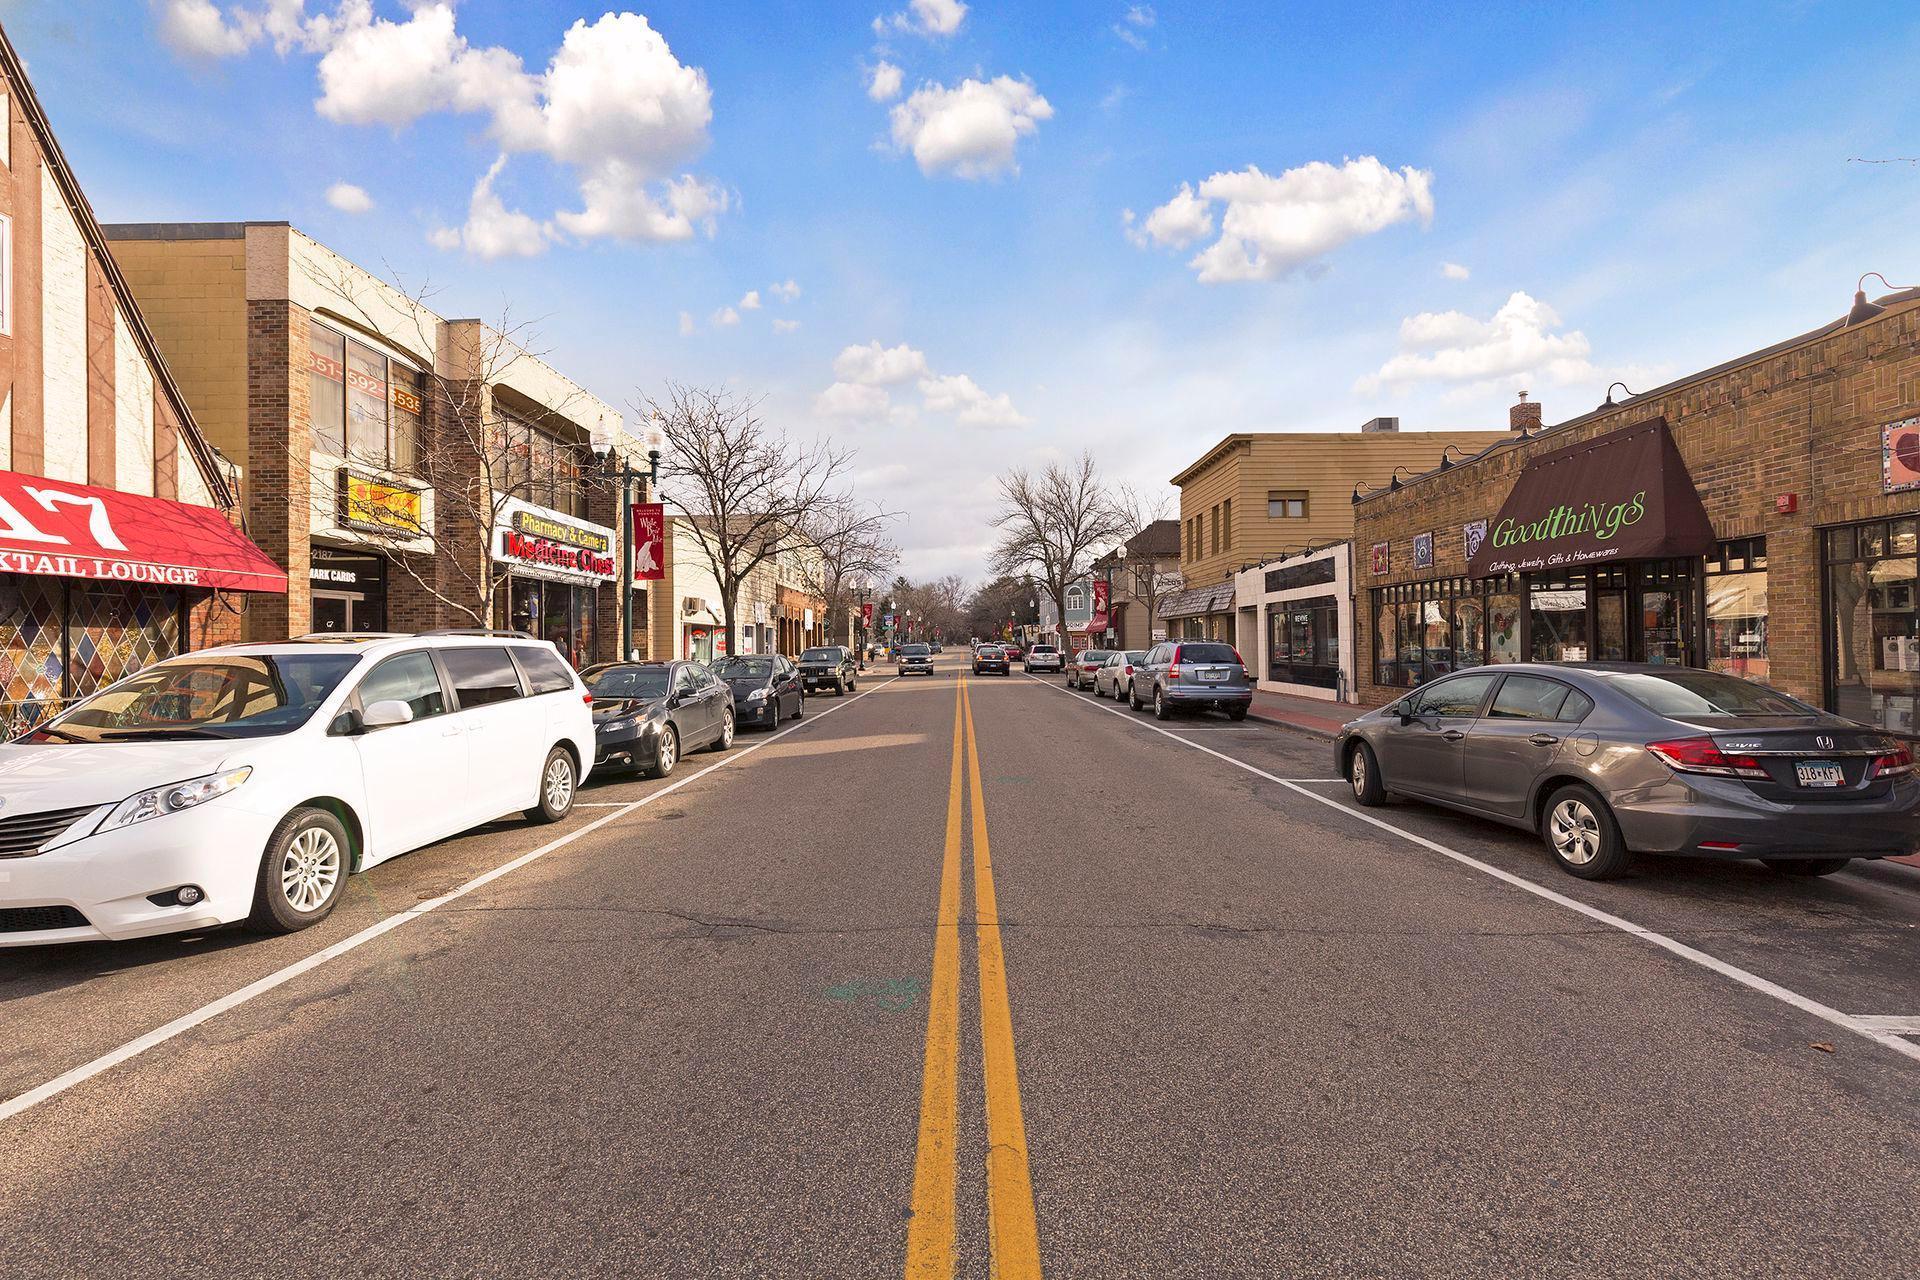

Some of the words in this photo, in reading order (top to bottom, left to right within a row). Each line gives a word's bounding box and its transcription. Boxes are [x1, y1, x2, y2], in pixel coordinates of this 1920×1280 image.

[521, 512, 567, 540] Pharmacy
[569, 527, 578, 543] &
[578, 530, 608, 552] Camera
[311, 549, 333, 559] 2187
[506, 531, 578, 569] Medicine
[580, 549, 615, 576] Chest
[93, 560, 199, 585] LOUNGE
[331, 570, 356, 583] CARDS
